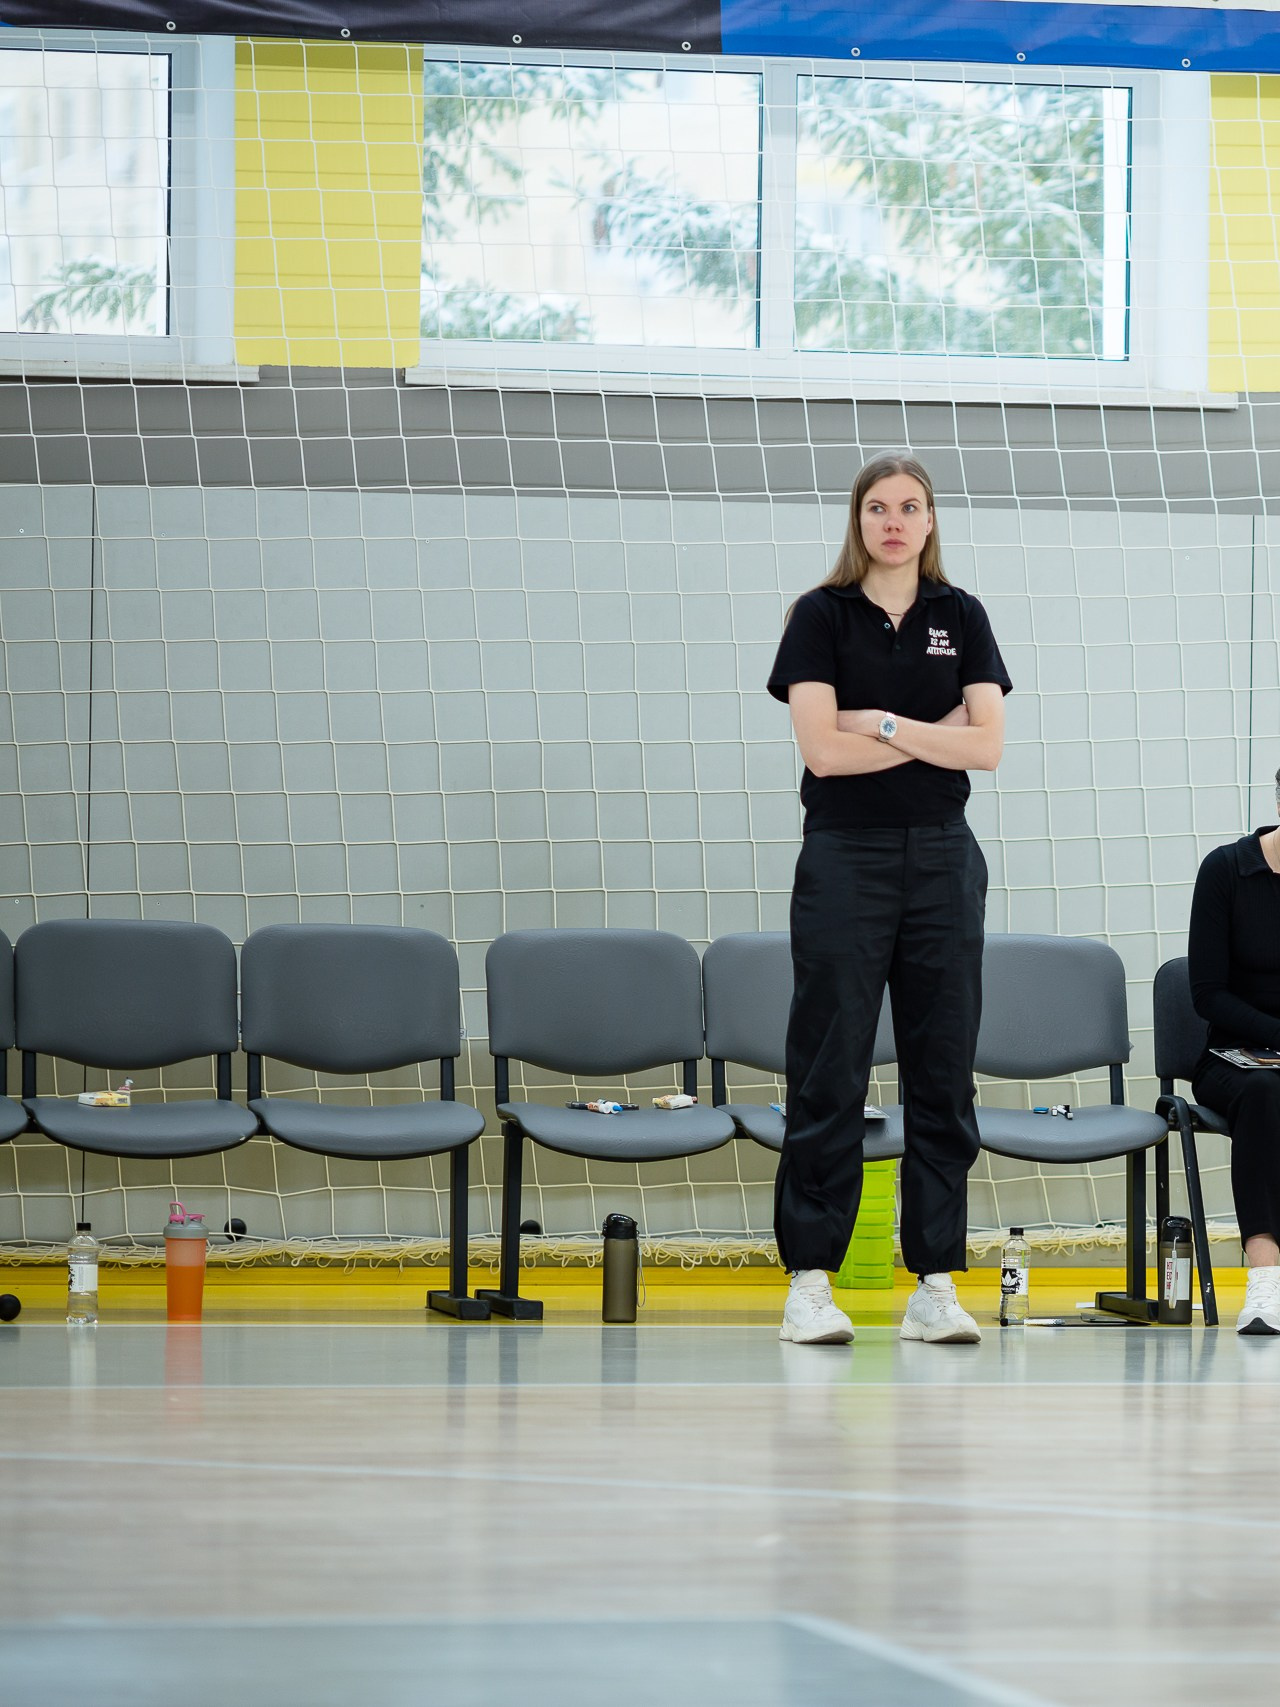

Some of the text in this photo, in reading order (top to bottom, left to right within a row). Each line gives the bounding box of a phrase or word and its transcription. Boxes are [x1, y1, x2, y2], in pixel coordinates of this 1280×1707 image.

[928, 627, 949, 638] BLACK
[930, 637, 950, 647] IS AN
[926, 646, 957, 656] ATTITUDE
